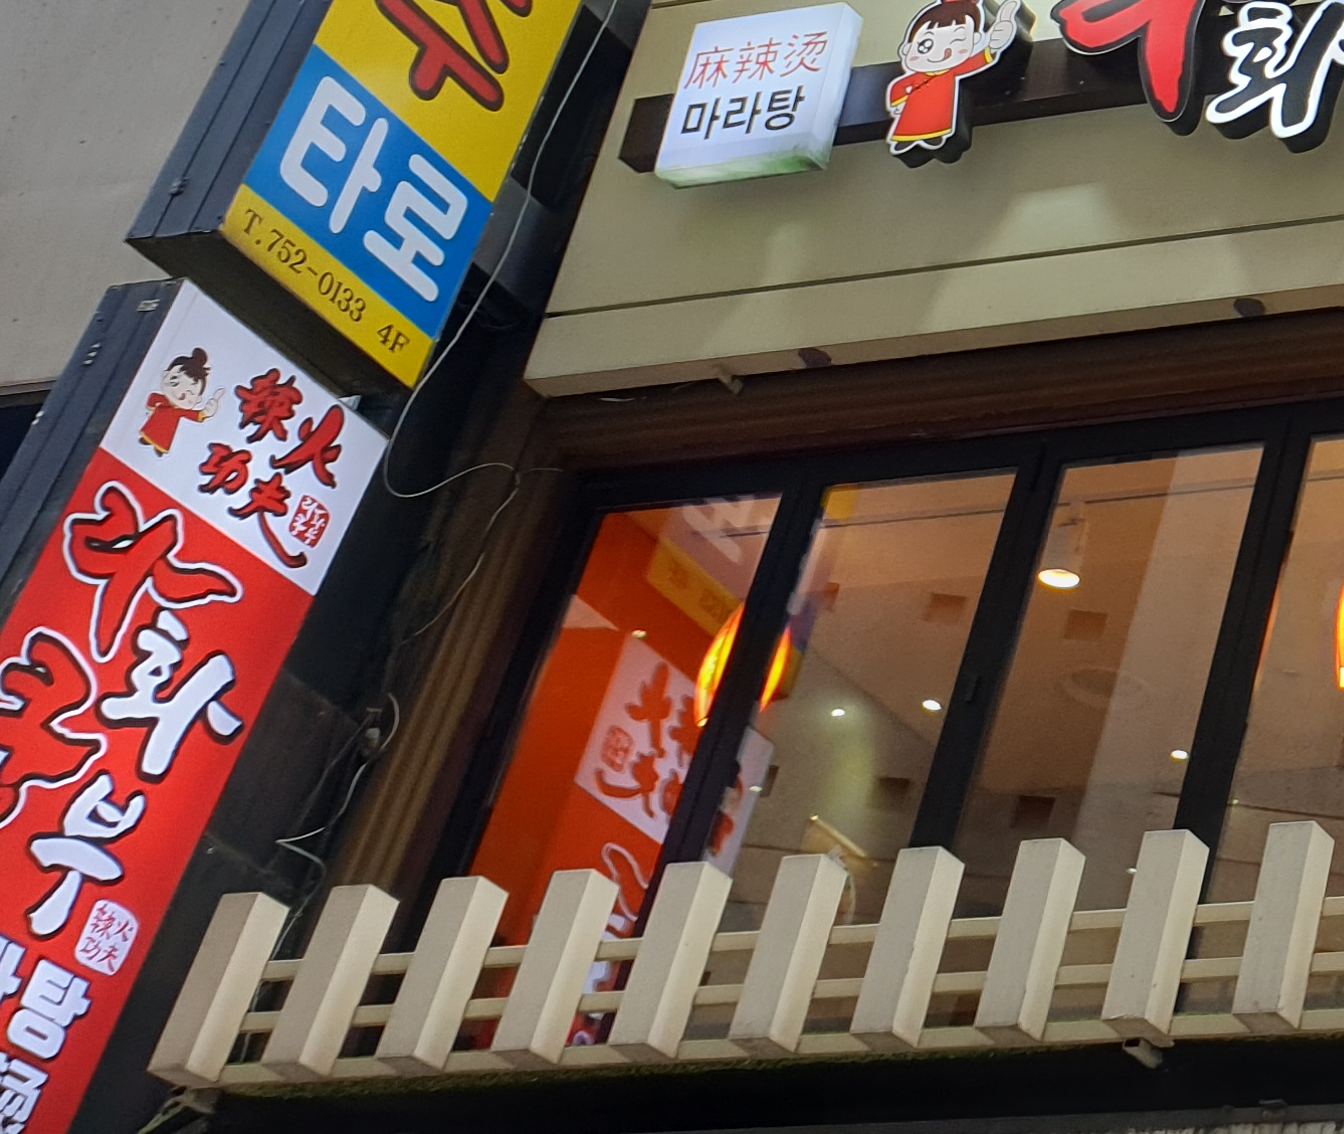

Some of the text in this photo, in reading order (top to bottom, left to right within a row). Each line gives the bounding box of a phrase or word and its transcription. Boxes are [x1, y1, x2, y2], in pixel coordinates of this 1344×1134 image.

[683, 31, 828, 90] 麻辣烫
[680, 84, 806, 140] 마라탕
[279, 74, 468, 304] 타로
[375, 321, 411, 356] 4F
